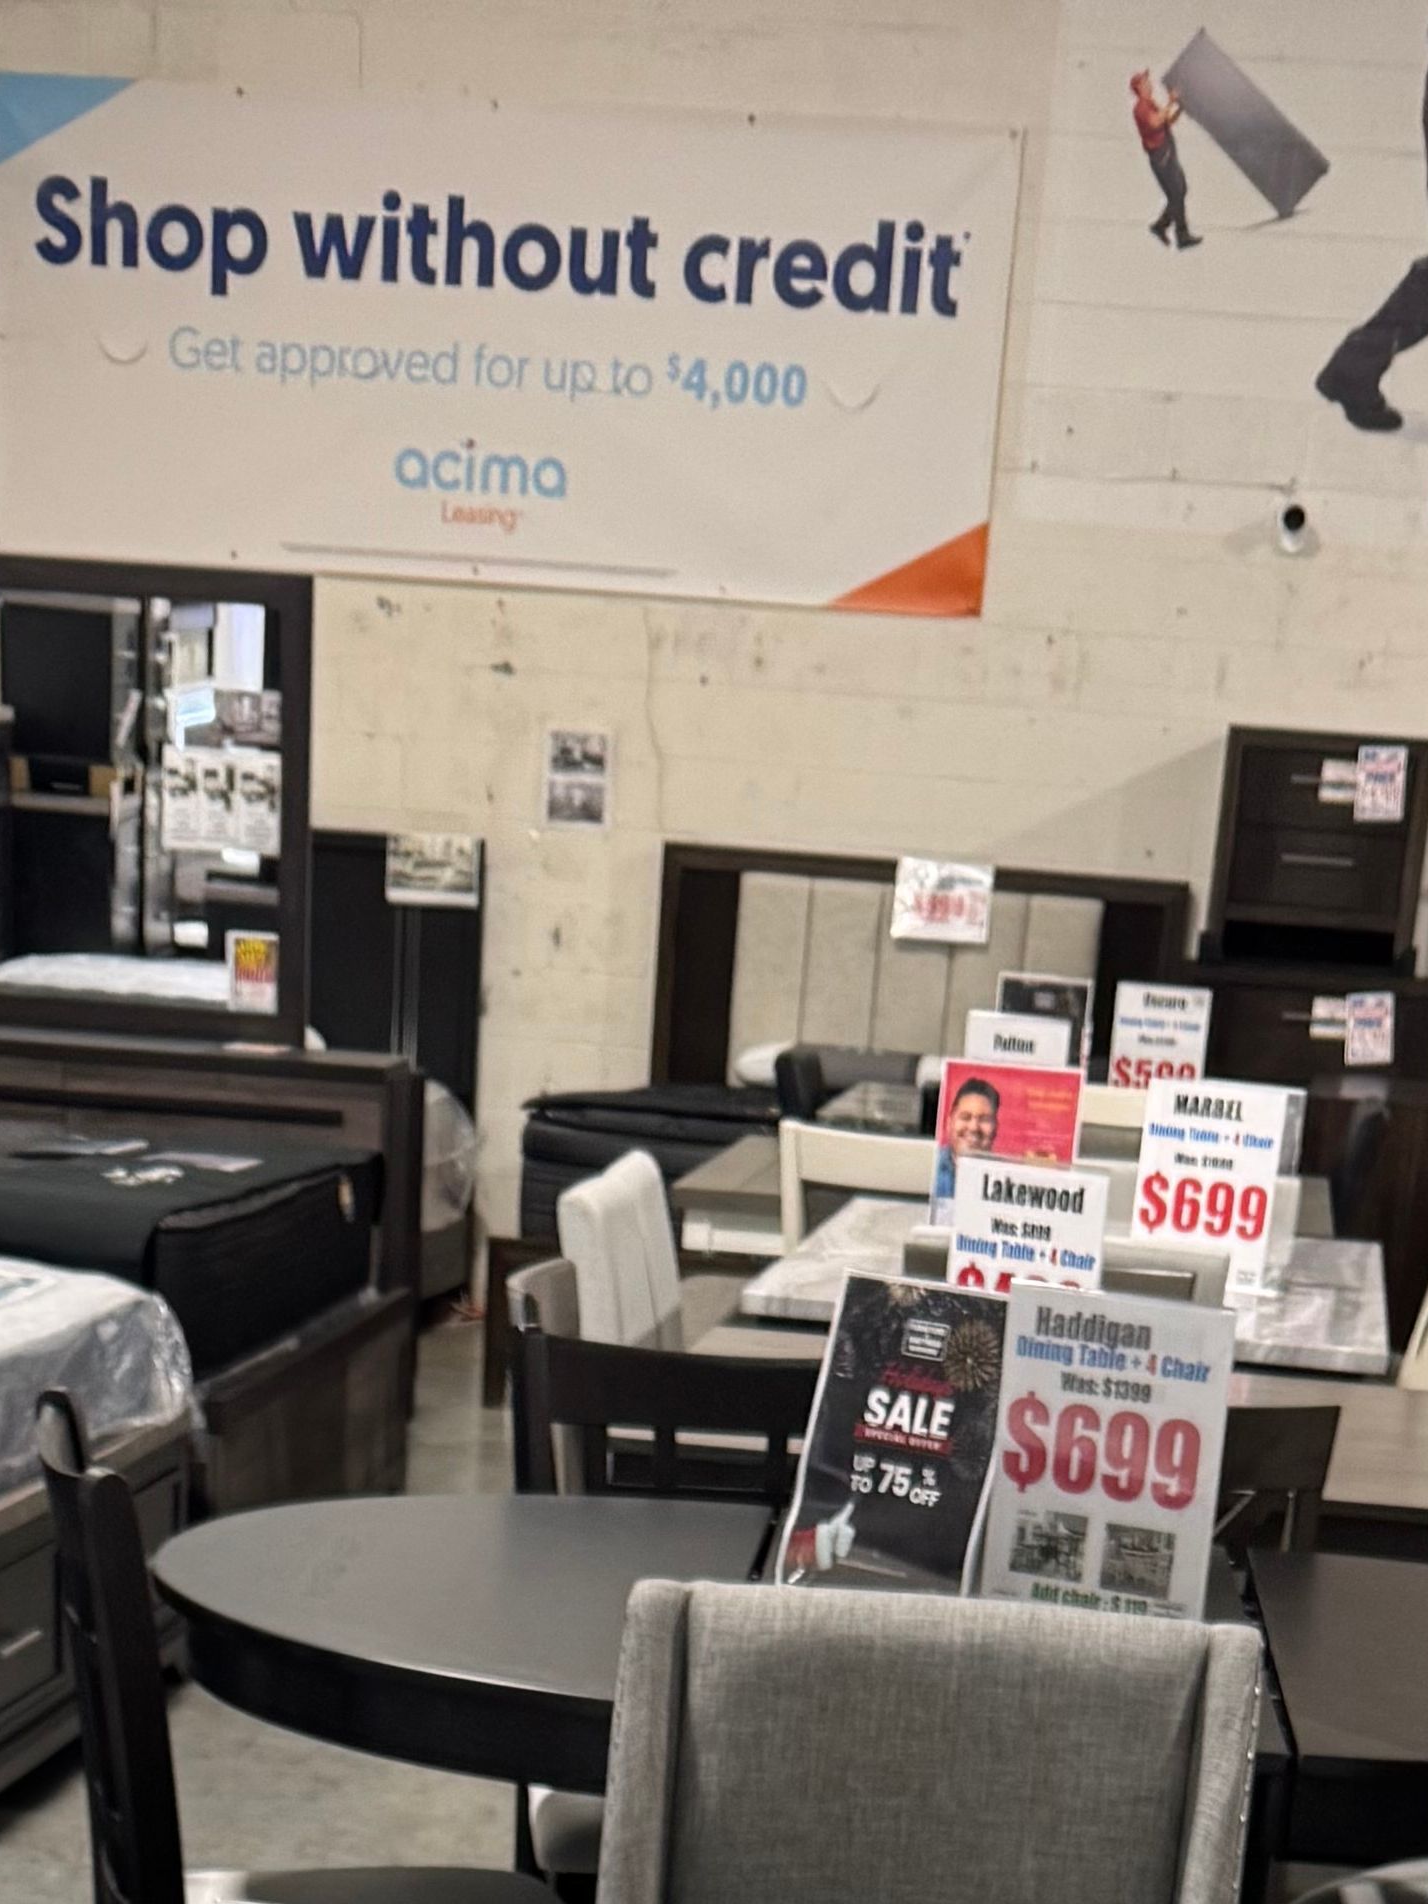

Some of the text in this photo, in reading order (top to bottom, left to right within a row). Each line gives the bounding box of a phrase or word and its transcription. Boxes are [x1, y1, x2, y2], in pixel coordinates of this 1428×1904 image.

[35, 175, 268, 296] Shop
[292, 189, 658, 299] without
[169, 326, 807, 410] Get approved for up to $4,000
[394, 438, 568, 499] acima
[441, 501, 519, 531] Leasing
[983, 1173, 1084, 1214] Lakewood
[1139, 1171, 1268, 1242] $699
[957, 1234, 997, 1258] Dining
[1002, 1241, 1035, 1262] Table
[1060, 1250, 1096, 1271] Chair
[1036, 1306, 1152, 1350] Haddigan
[1016, 1335, 1072, 1366] Dining
[1079, 1343, 1127, 1371] Table
[1161, 1355, 1210, 1383] Chair
[864, 1387, 955, 1438] SALE
[853, 1454, 876, 1473] UP
[1002, 1391, 1201, 1511] $699
[850, 1474, 872, 1494] TO
[878, 1462, 912, 1498] 75
[909, 1487, 942, 1507] OFF
